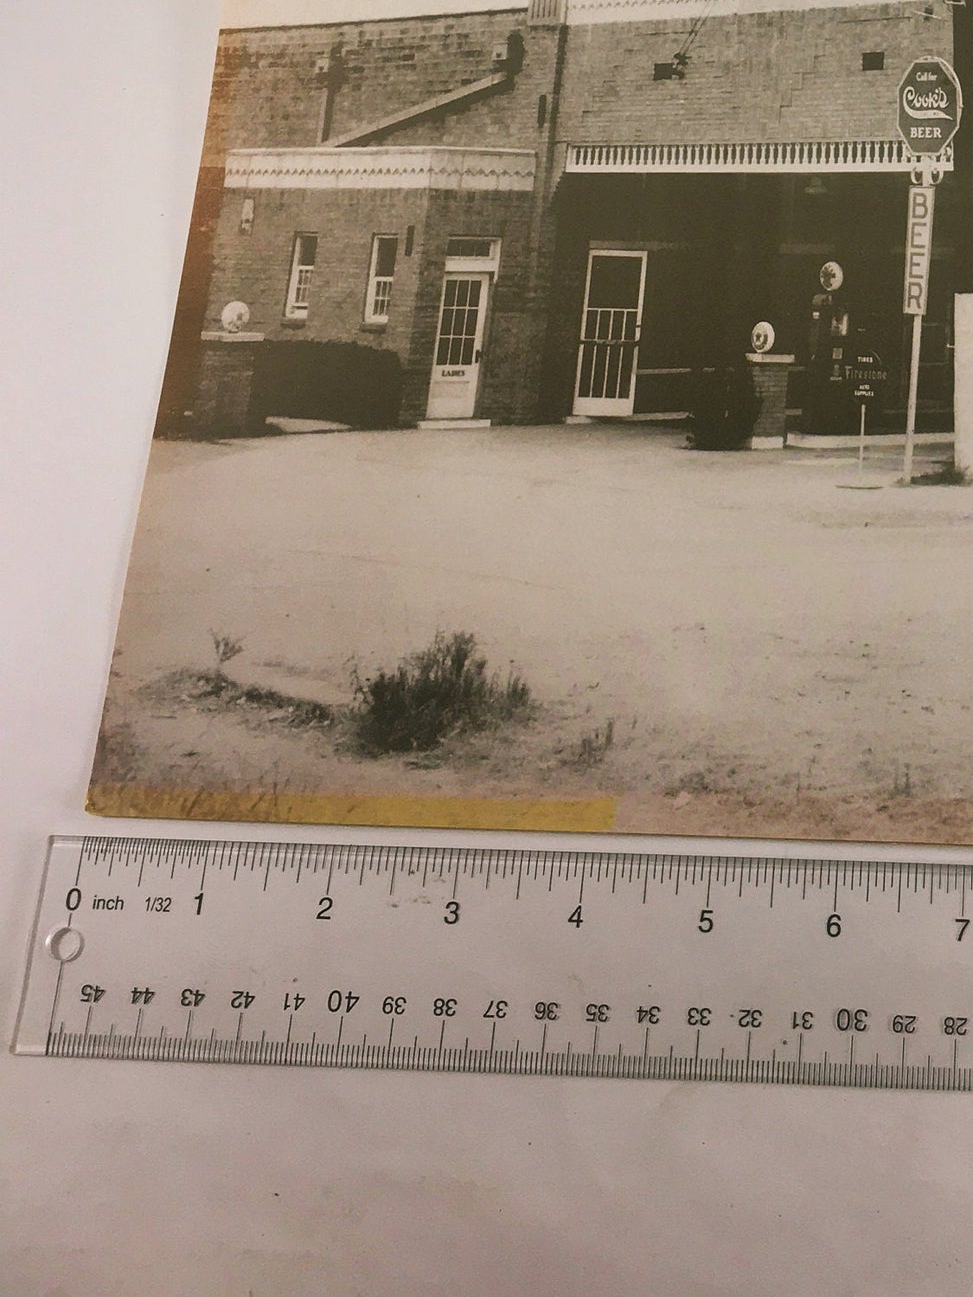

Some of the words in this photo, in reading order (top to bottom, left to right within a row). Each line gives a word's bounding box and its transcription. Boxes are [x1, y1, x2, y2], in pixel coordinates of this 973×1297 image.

[915, 71, 928, 82] Call
[928, 71, 938, 82] for
[903, 86, 953, 120] Cook's
[910, 126, 942, 139] BEER
[907, 192, 929, 309] BEER
[66, 888, 81, 911] 0
[92, 895, 124, 910] inch
[145, 897, 172, 912] 1/32
[194, 893, 204, 915] 1
[316, 897, 333, 920] 2
[444, 901, 461, 924] 3
[568, 905, 583, 928] 4
[698, 910, 713, 933] 5
[826, 914, 841, 938] 6
[955, 919, 970, 942] 7
[80, 984, 106, 1003] 45
[131, 987, 156, 1005] 44
[181, 989, 206, 1007] 43
[231, 991, 255, 1009] 42
[284, 993, 305, 1011] 41
[328, 990, 360, 1013] 40
[382, 996, 407, 1015] 39
[433, 998, 457, 1017] 38
[483, 1000, 508, 1018] 37
[535, 1002, 561, 1020] 36
[586, 1004, 611, 1022] 35
[636, 1006, 661, 1024] 34
[687, 1007, 712, 1026] 33
[738, 1009, 763, 1028] 32
[792, 1012, 813, 1030] 31
[837, 1009, 869, 1032] 30
[893, 1015, 917, 1034] 29
[944, 1017, 968, 1036] 28
